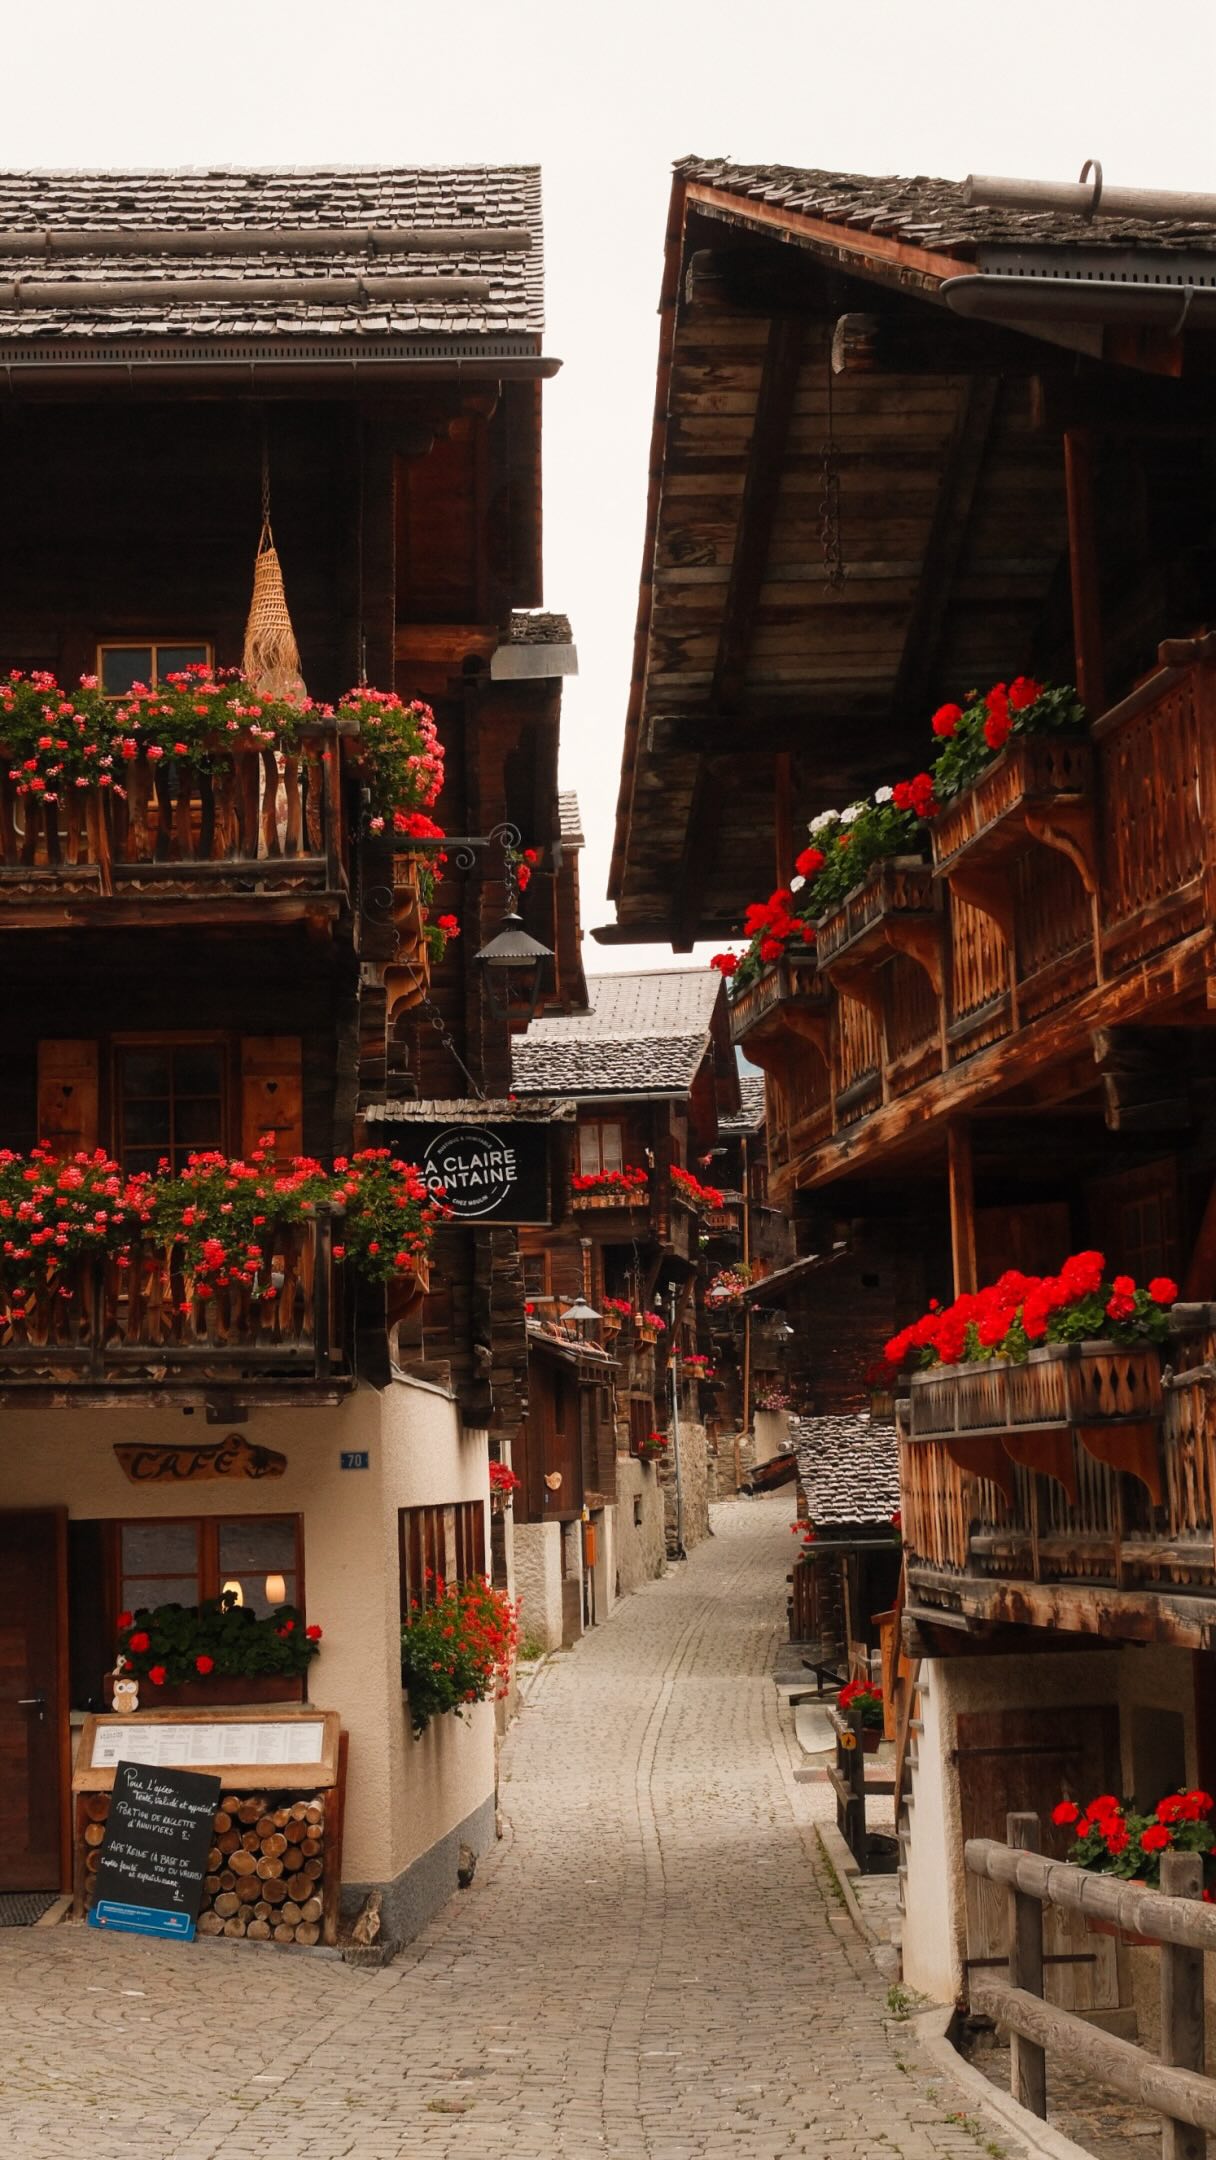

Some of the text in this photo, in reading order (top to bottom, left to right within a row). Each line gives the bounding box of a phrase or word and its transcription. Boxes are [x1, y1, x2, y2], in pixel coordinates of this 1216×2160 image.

[443, 1149, 517, 1172] CLAIRE
[452, 1198, 467, 1206] CHEZ
[347, 1453, 363, 1468] 70
[123, 1767, 144, 1789] Pour
[151, 1813, 163, 1822] DE
[178, 1859, 191, 1868] DE
